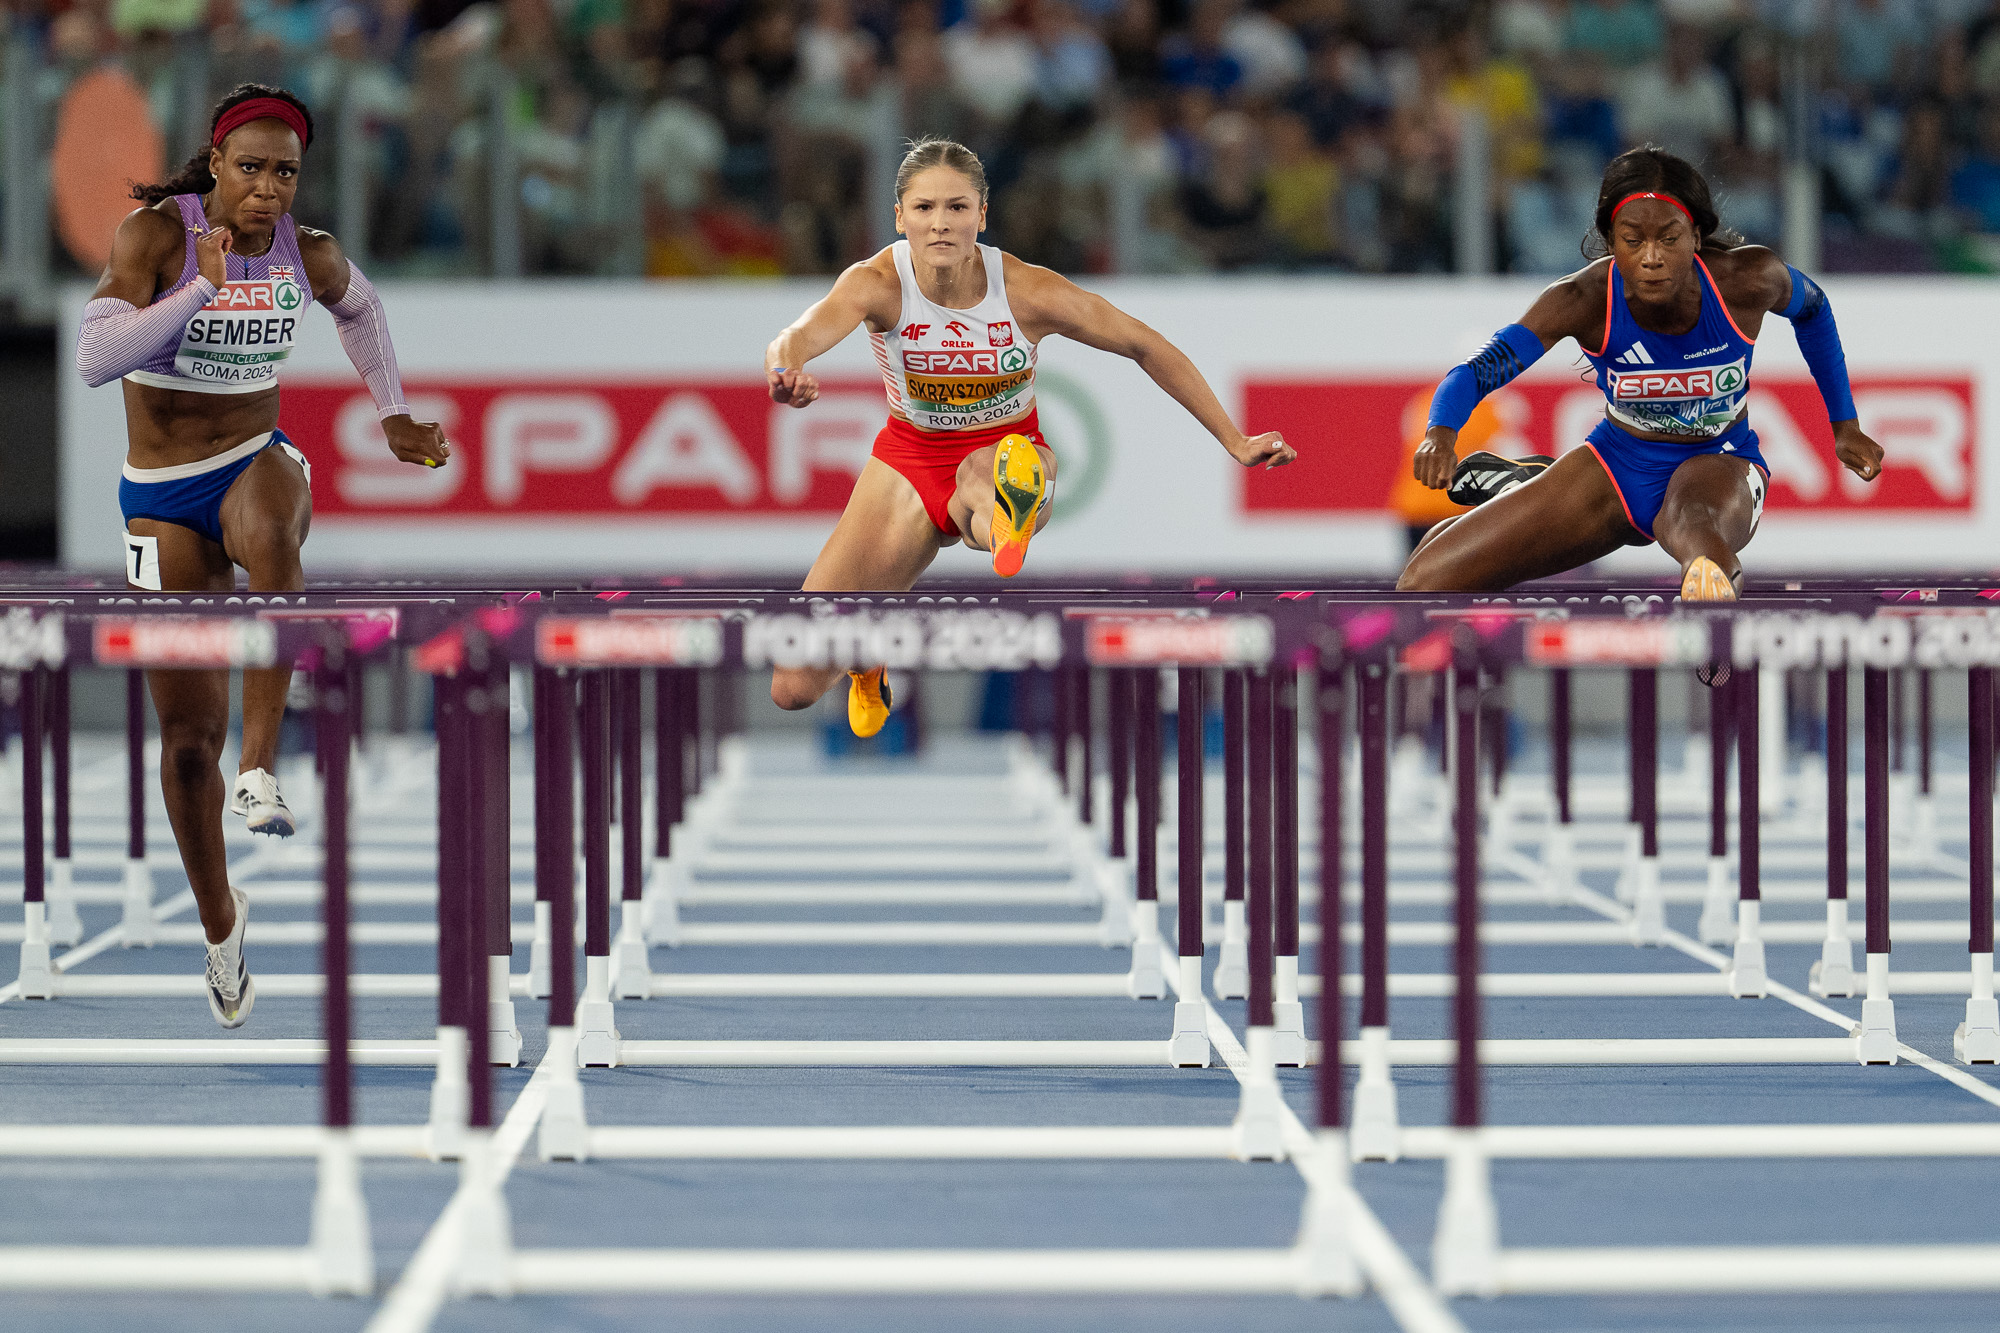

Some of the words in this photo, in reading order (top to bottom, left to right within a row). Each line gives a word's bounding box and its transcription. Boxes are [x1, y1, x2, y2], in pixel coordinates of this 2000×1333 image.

[205, 286, 271, 307] PAR
[187, 317, 296, 345] SEMBER
[900, 322, 931, 341] 4F
[941, 340, 974, 348] ORLEN
[209, 353, 235, 362] RUN
[236, 353, 269, 364] CLEAN
[904, 353, 996, 372] SPAR
[191, 361, 240, 380] ROMA
[242, 364, 274, 380] 2024
[908, 372, 1029, 402] SKRZYSZOWSKA
[1619, 374, 1711, 397] SPAR
[928, 414, 981, 426] ROMA
[983, 398, 1022, 422] 2024
[940, 404, 967, 413] RUN
[968, 394, 1007, 411] CLEAN
[334, 391, 888, 507] SPAR
[129, 543, 144, 580] 7
